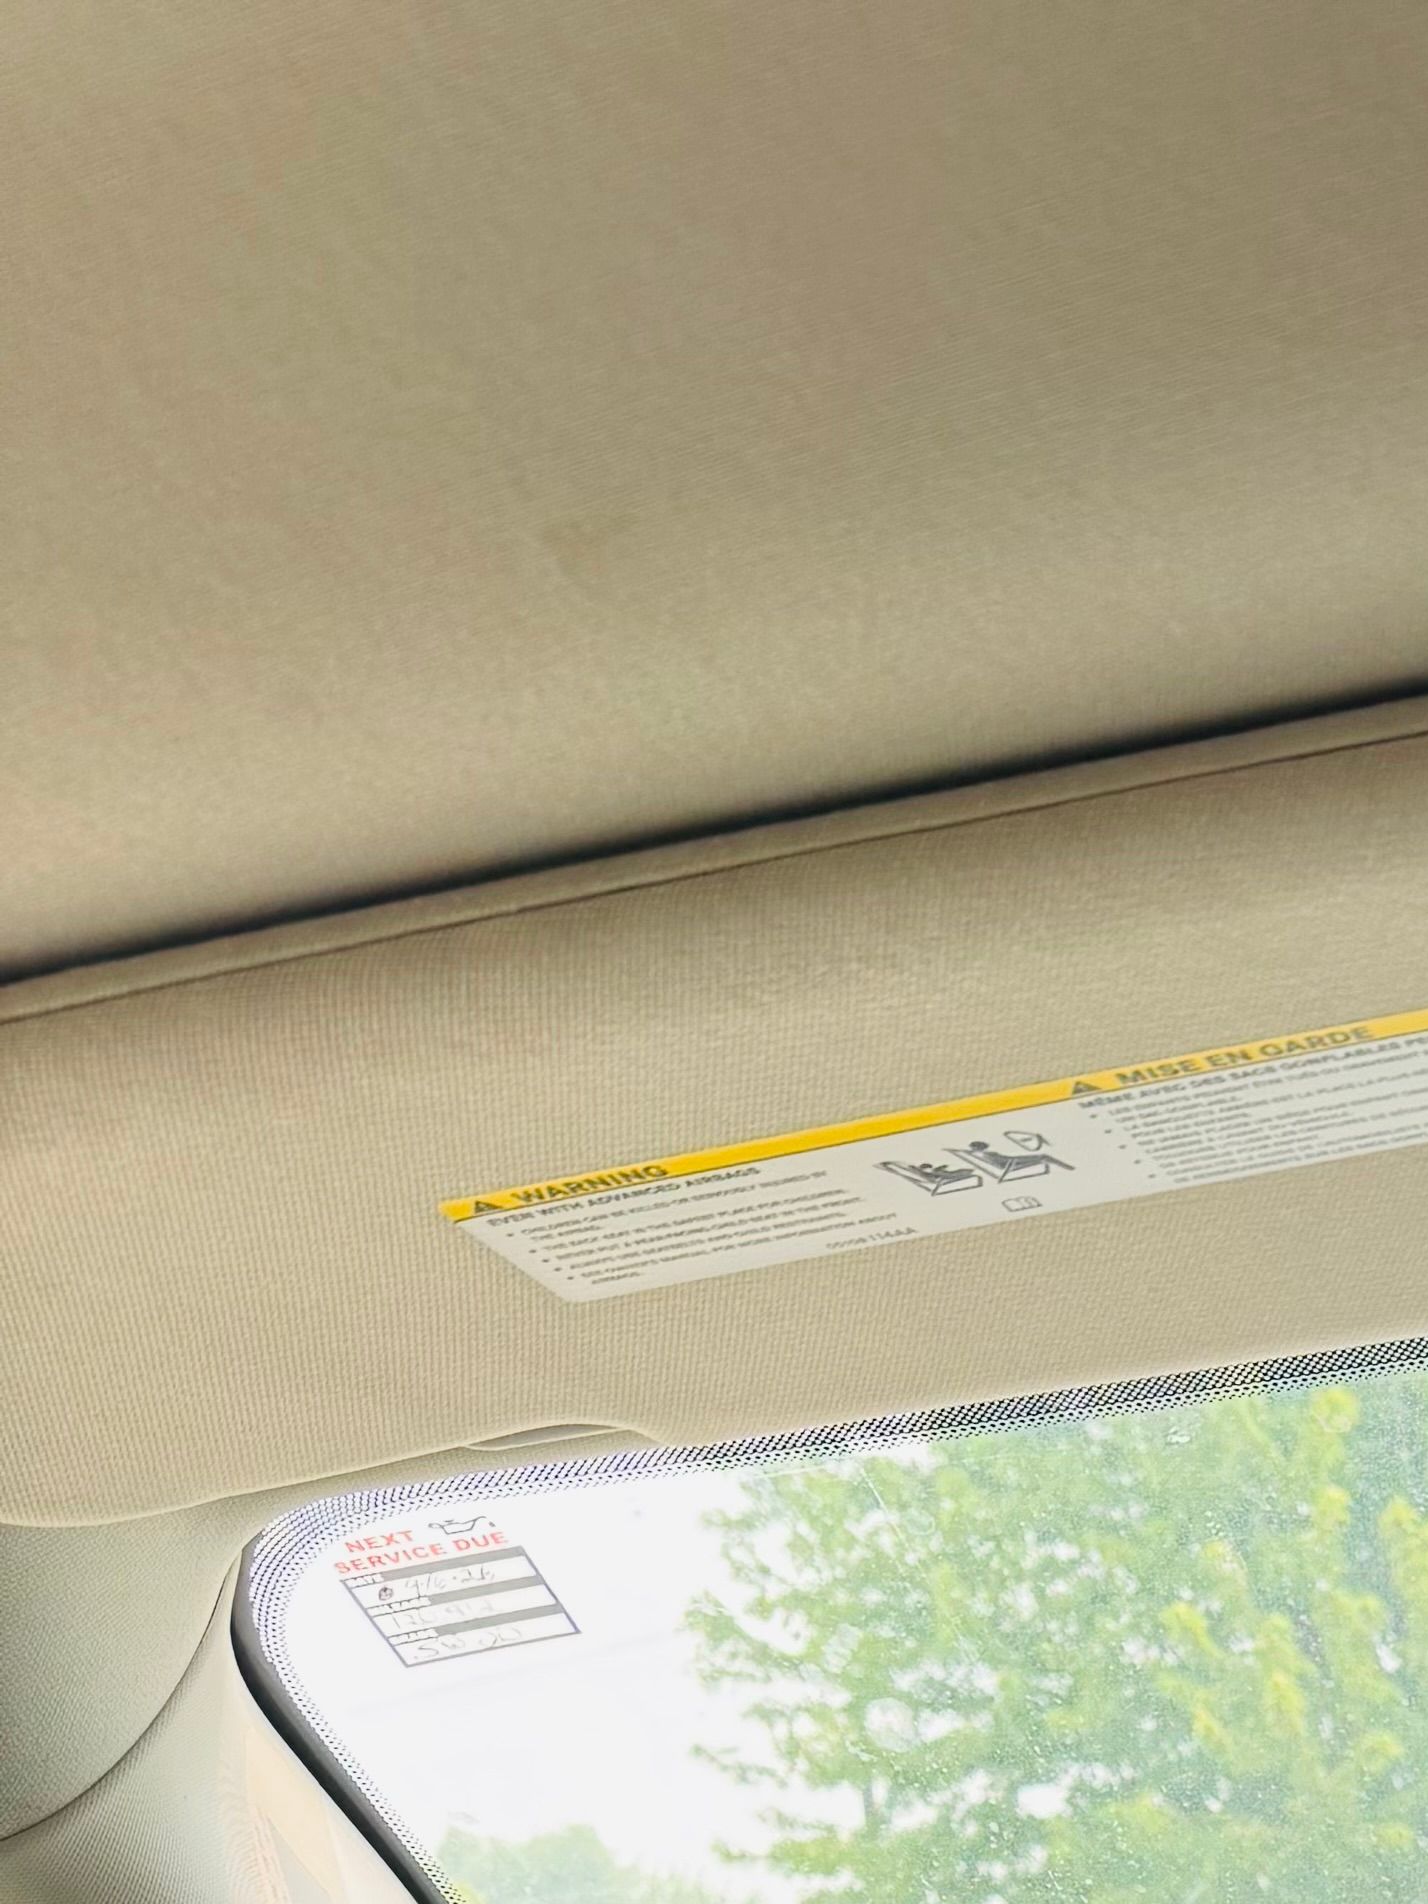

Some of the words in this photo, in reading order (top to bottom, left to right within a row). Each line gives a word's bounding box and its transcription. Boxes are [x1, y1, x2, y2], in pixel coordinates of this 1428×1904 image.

[1115, 1058, 1199, 1084] MISE
[1206, 1049, 1250, 1067] EN
[1258, 1025, 1372, 1057] GARDE
[508, 1163, 669, 1204] WARNING
[334, 1546, 446, 1575] SERVICE
[452, 1531, 508, 1552] DUE
[345, 1530, 414, 1553] NEXT
